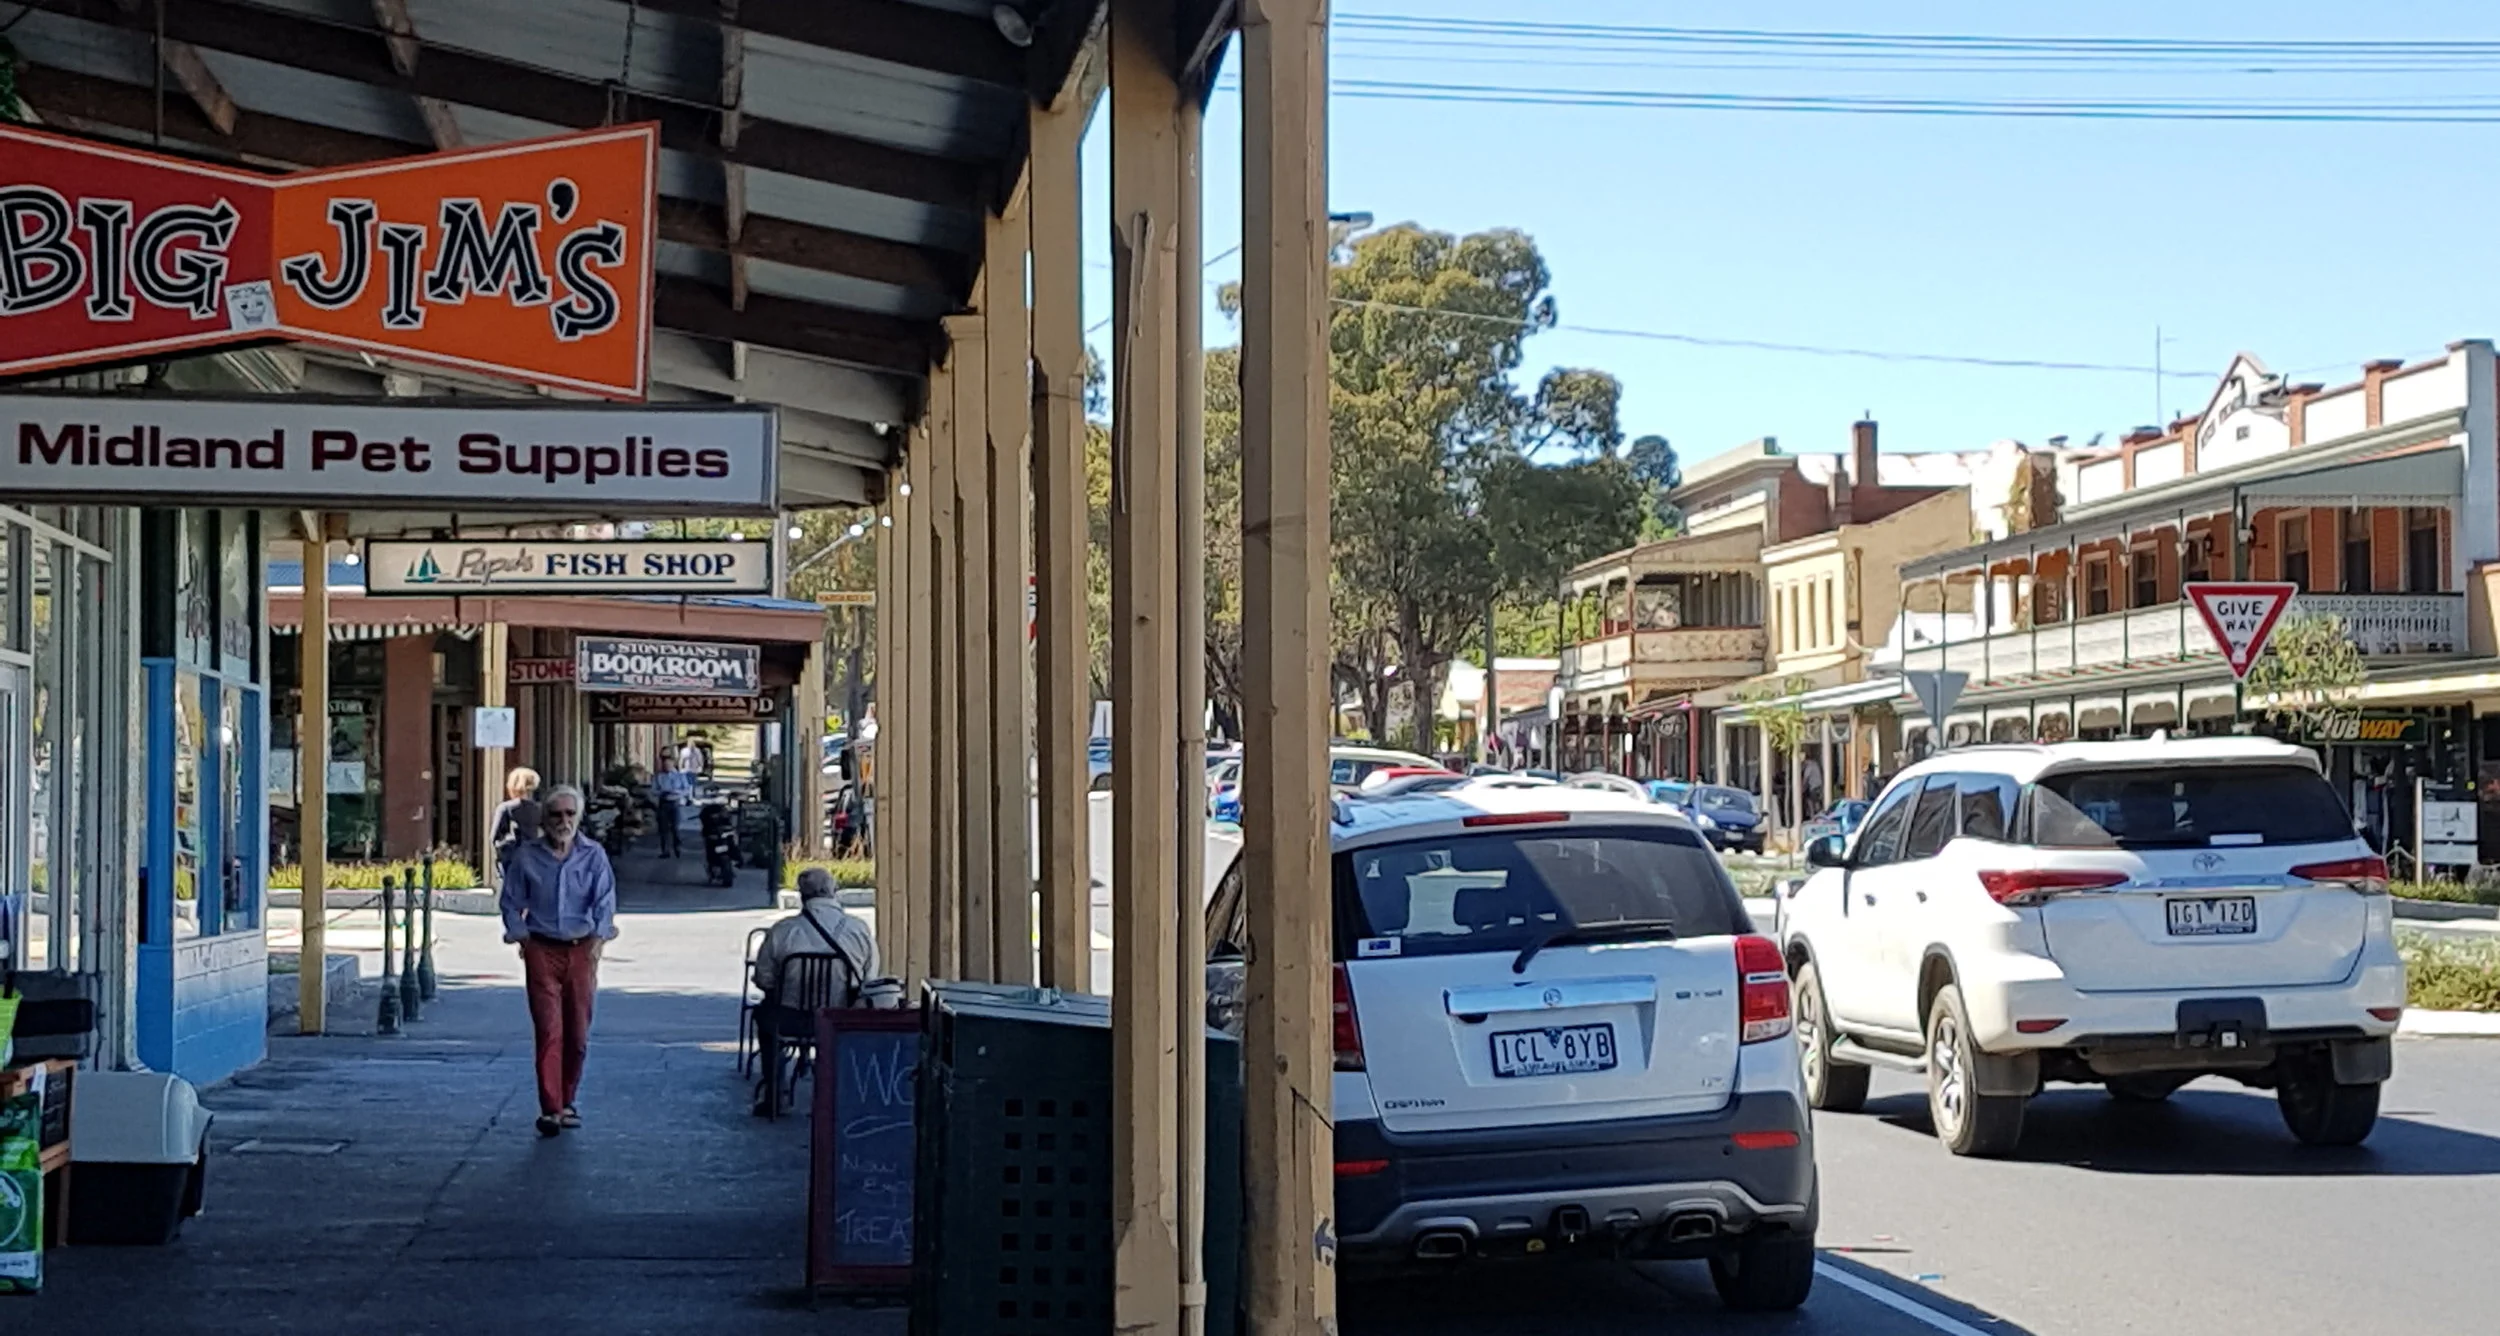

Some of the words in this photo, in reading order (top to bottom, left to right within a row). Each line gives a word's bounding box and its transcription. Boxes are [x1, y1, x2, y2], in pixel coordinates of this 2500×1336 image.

[0, 185, 240, 320] BIG
[281, 178, 626, 341] JIM'S
[18, 423, 284, 469] Midland
[312, 430, 431, 472] Pet
[458, 433, 729, 484] Supplies
[546, 553, 627, 576] FISH
[643, 554, 736, 576] SHOP
[2217, 601, 2263, 615] GIVE
[2226, 620, 2256, 631] WAY
[592, 653, 743, 678] BOOKROOM
[1564, 1032, 1609, 1059] 8YB
